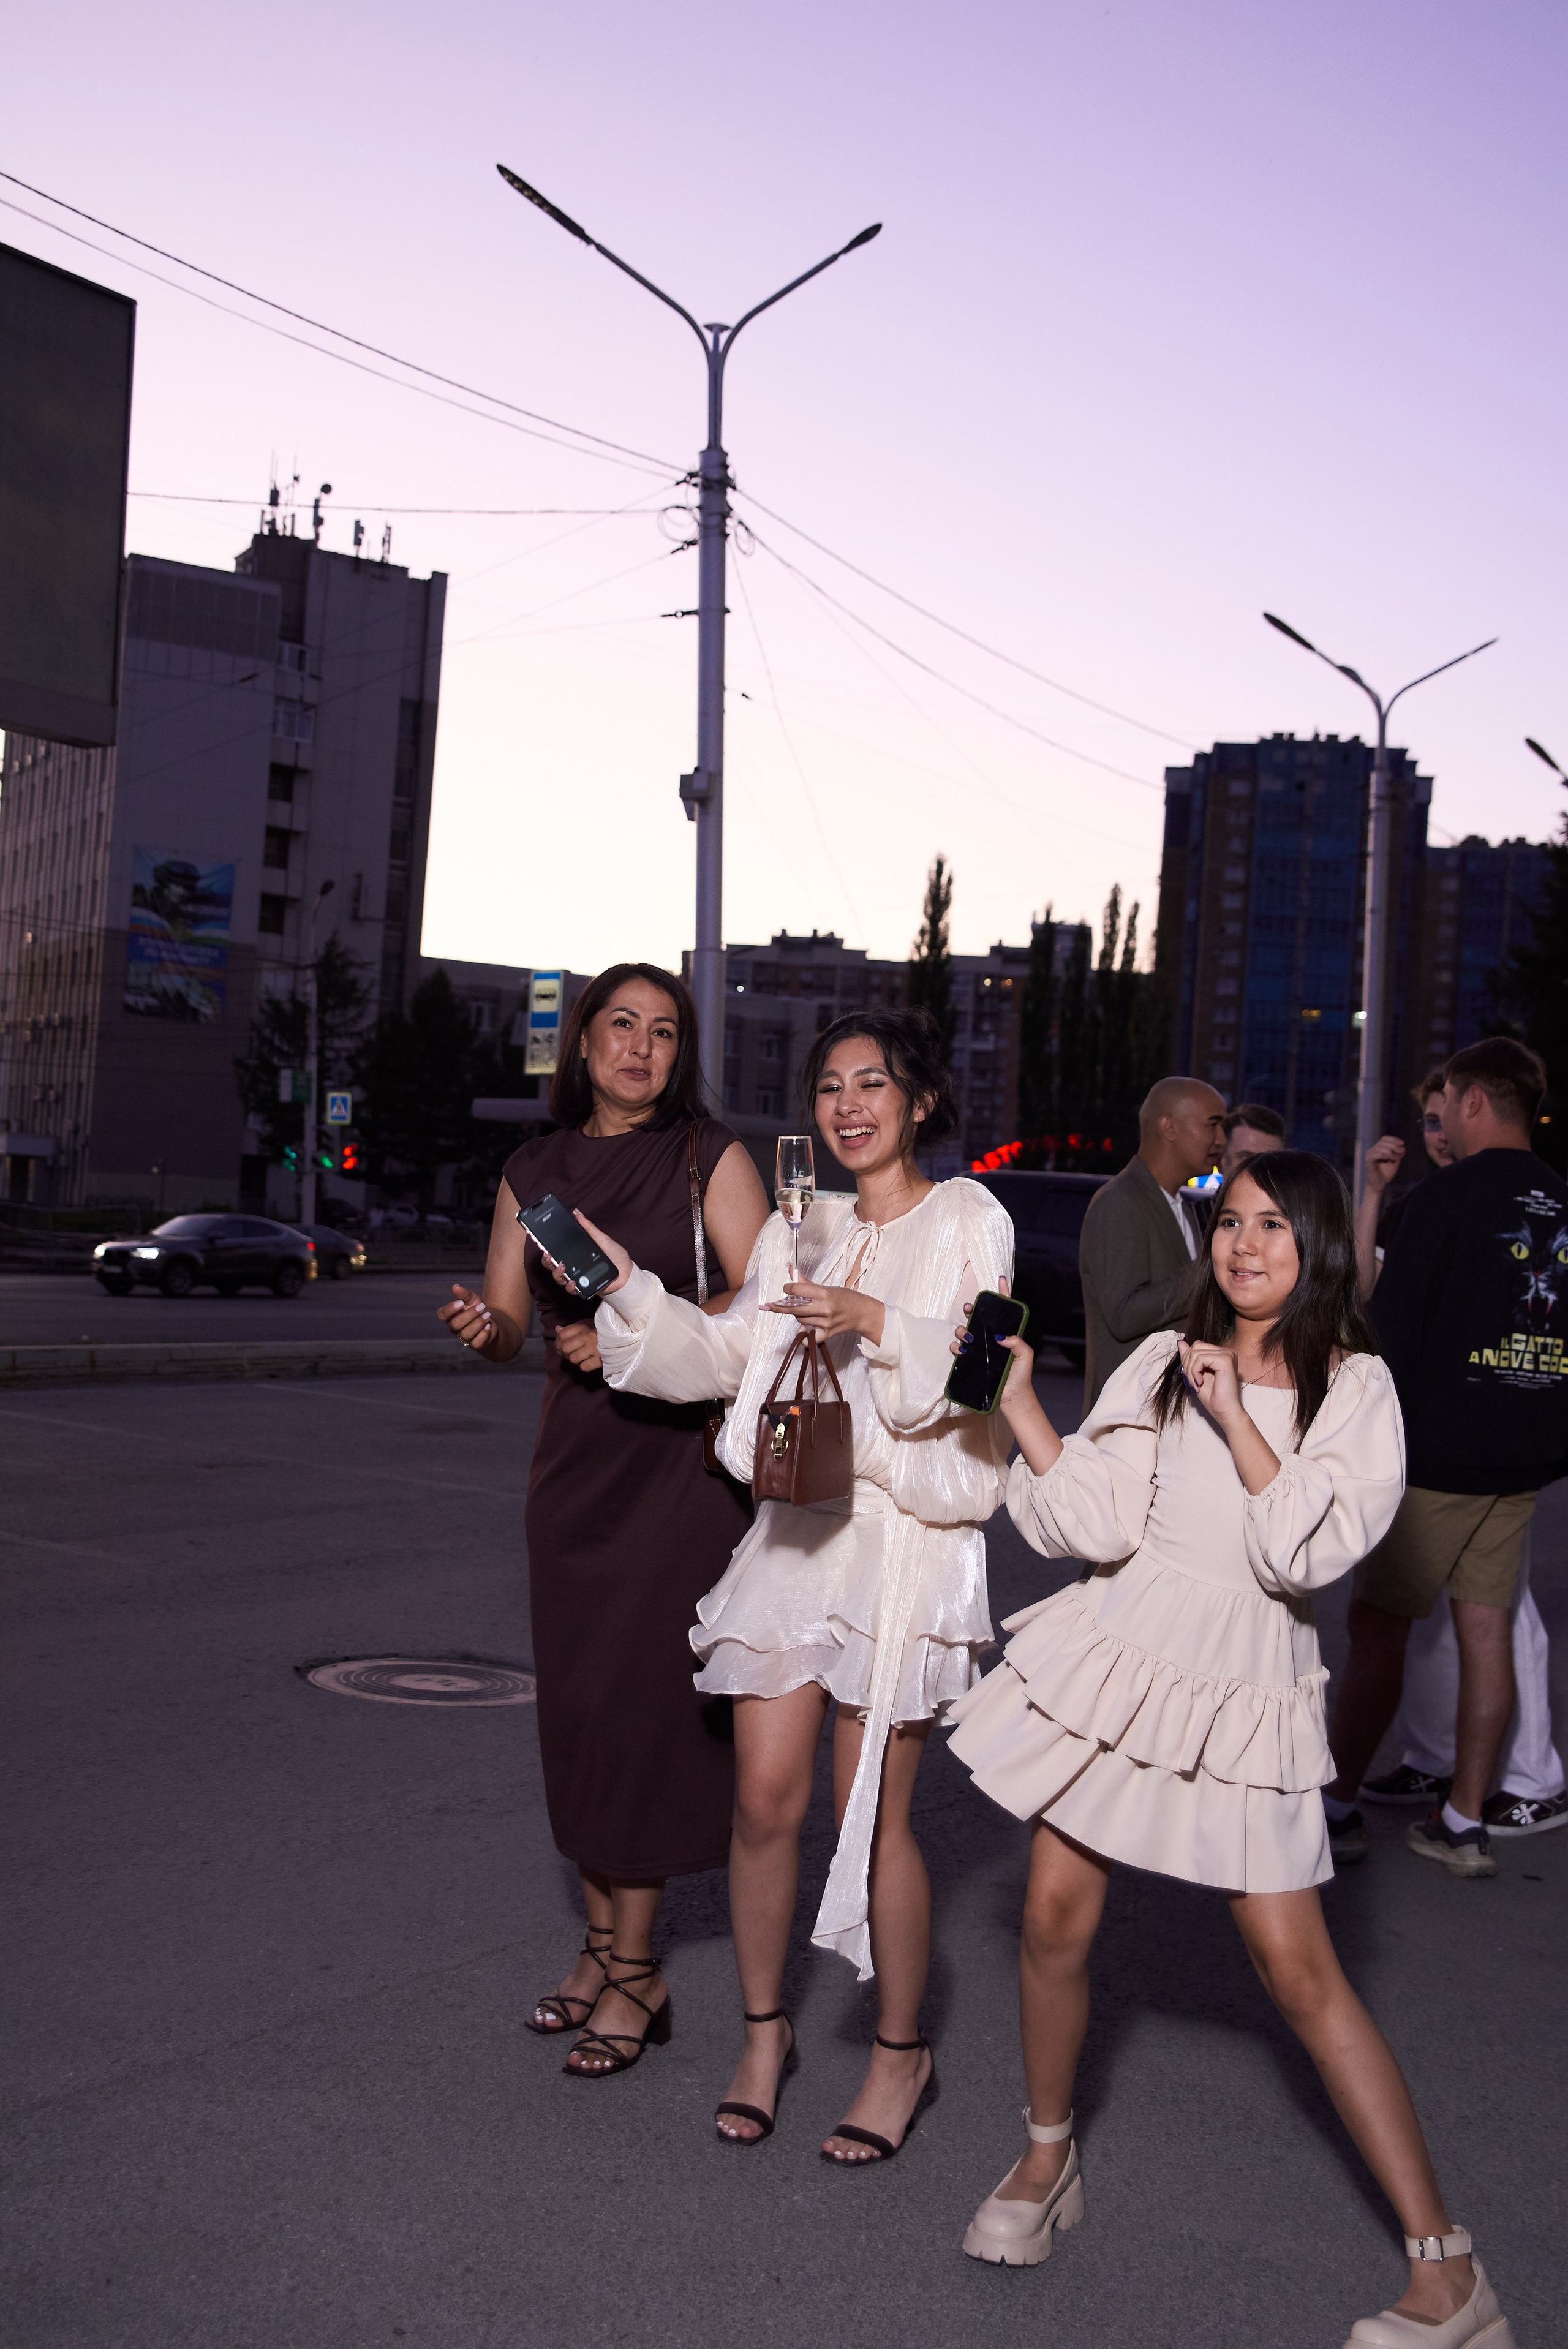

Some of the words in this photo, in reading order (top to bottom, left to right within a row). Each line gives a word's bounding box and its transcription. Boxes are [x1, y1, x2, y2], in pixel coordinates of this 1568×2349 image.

[1500, 1337, 1509, 1349] IL
[1511, 1332, 1564, 1355] GATTO
[1468, 1351, 1480, 1364] A
[1482, 1348, 1535, 1371] NOVE
